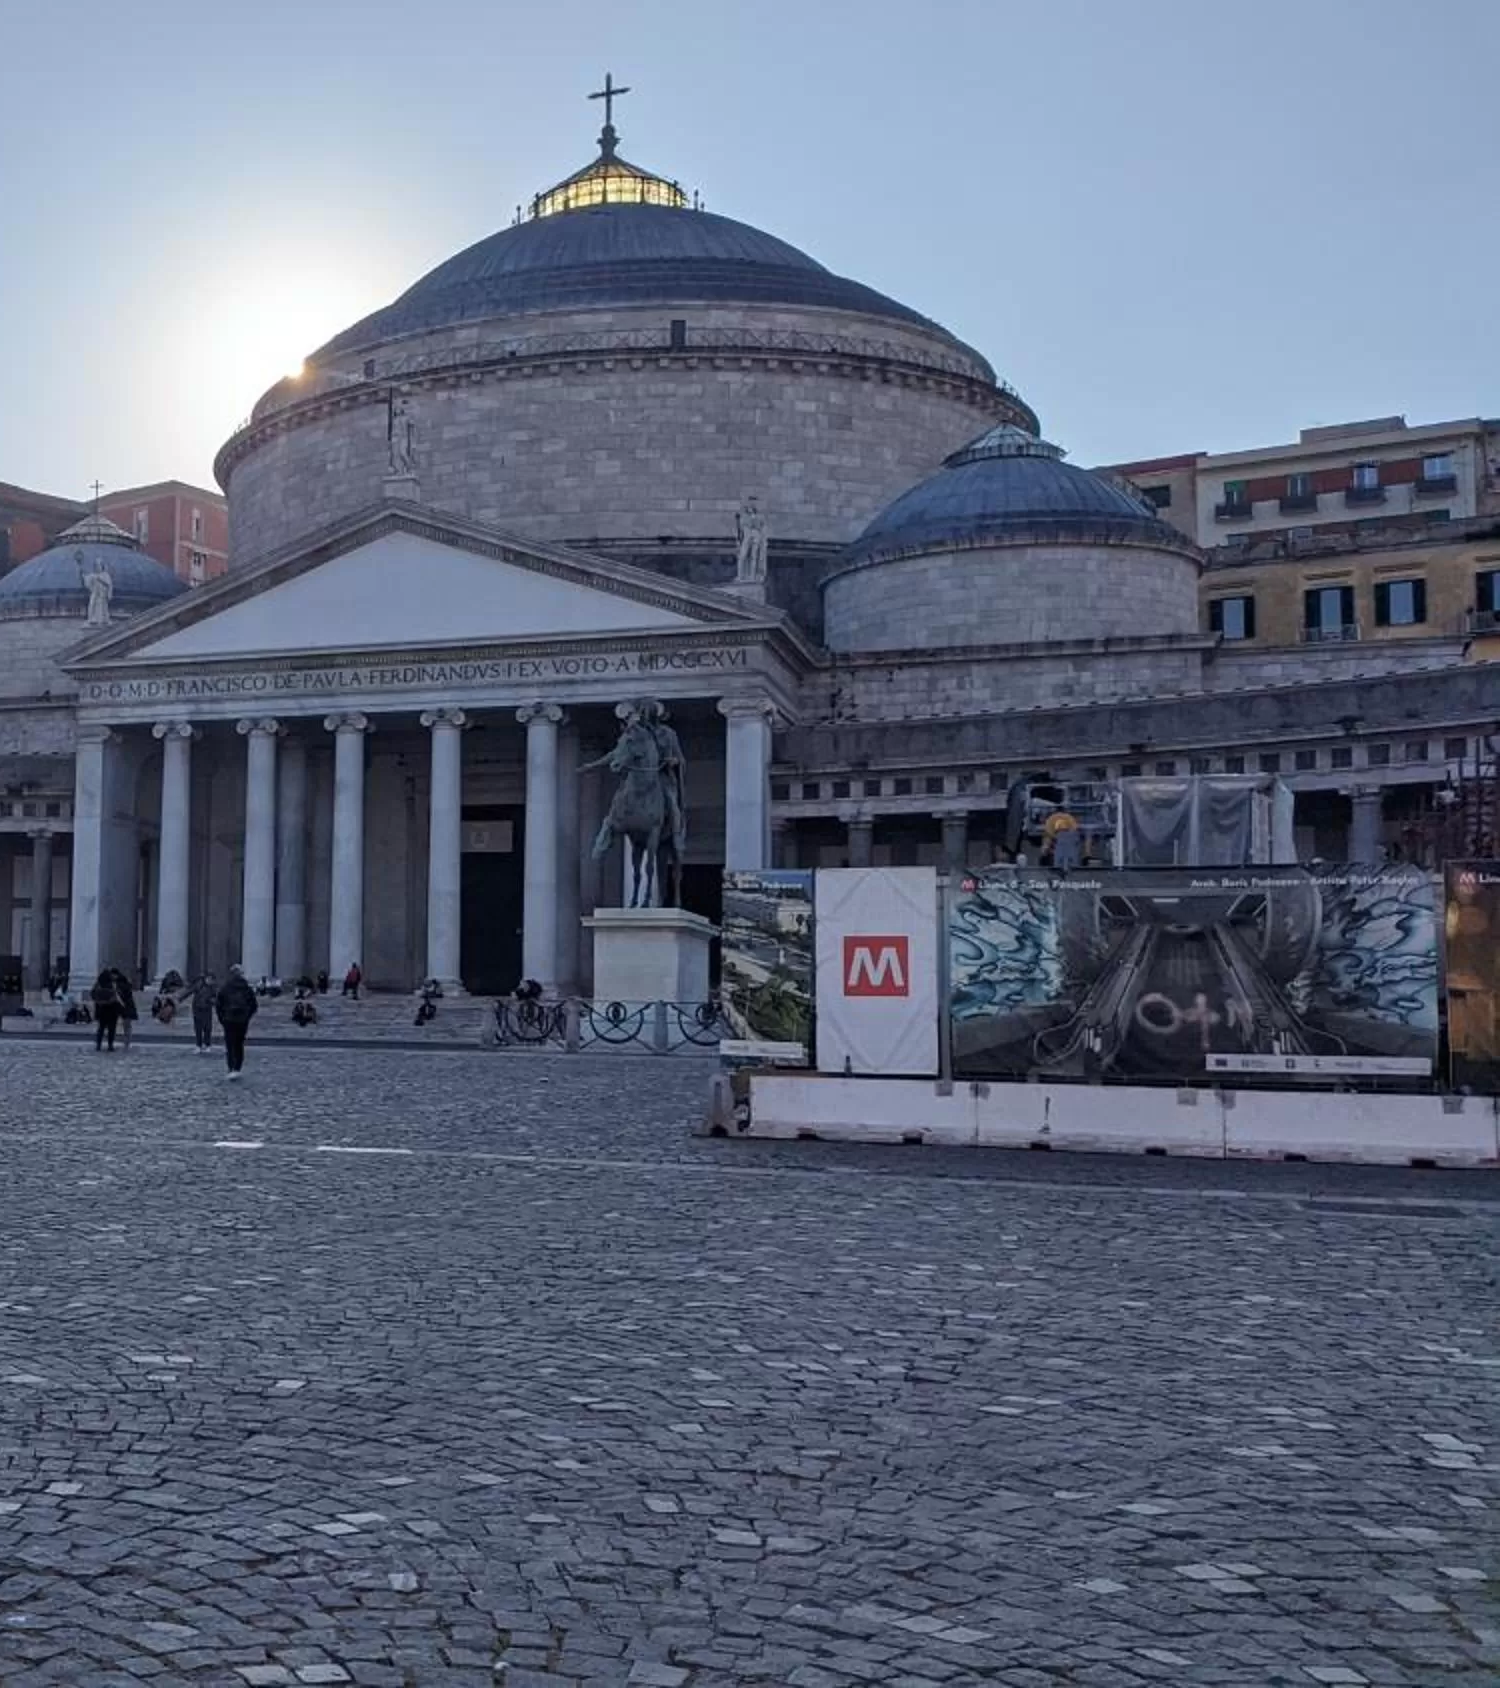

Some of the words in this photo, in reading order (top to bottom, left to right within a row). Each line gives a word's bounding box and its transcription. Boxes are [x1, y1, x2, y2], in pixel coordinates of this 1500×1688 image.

[167, 675, 267, 696] FRANCISCO
[273, 673, 297, 689] DE
[303, 671, 362, 689] PAVLA
[369, 663, 500, 685] FERDINANDVS
[519, 660, 543, 677] EX
[551, 657, 609, 674] VOTO
[846, 946, 905, 988] M
